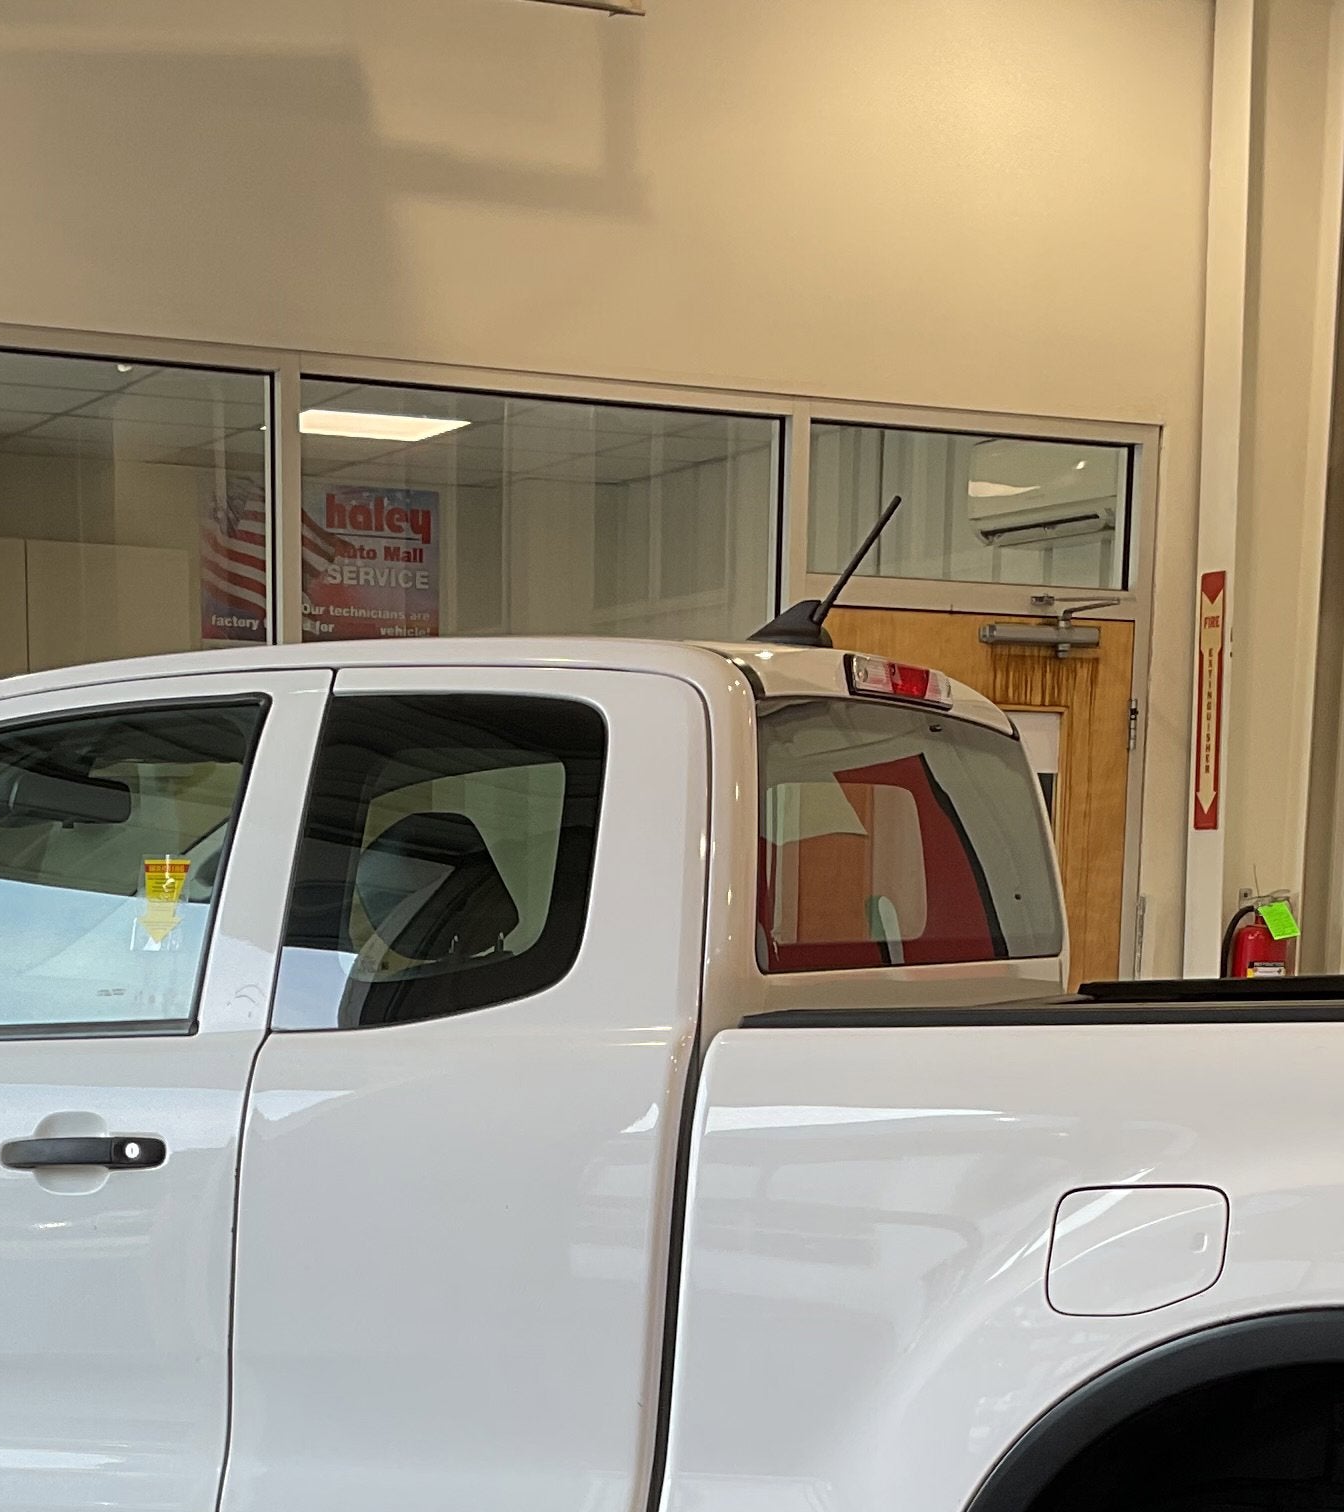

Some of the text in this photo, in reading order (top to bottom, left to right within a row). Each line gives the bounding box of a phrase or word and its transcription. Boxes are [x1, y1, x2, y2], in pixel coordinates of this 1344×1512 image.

[325, 494, 431, 544] haley
[334, 545, 423, 563] uto Mall
[327, 565, 430, 589] SERVICE
[330, 605, 406, 620] technicians
[410, 611, 431, 621] are
[212, 615, 260, 631] factory
[1204, 615, 1220, 629] FIRE
